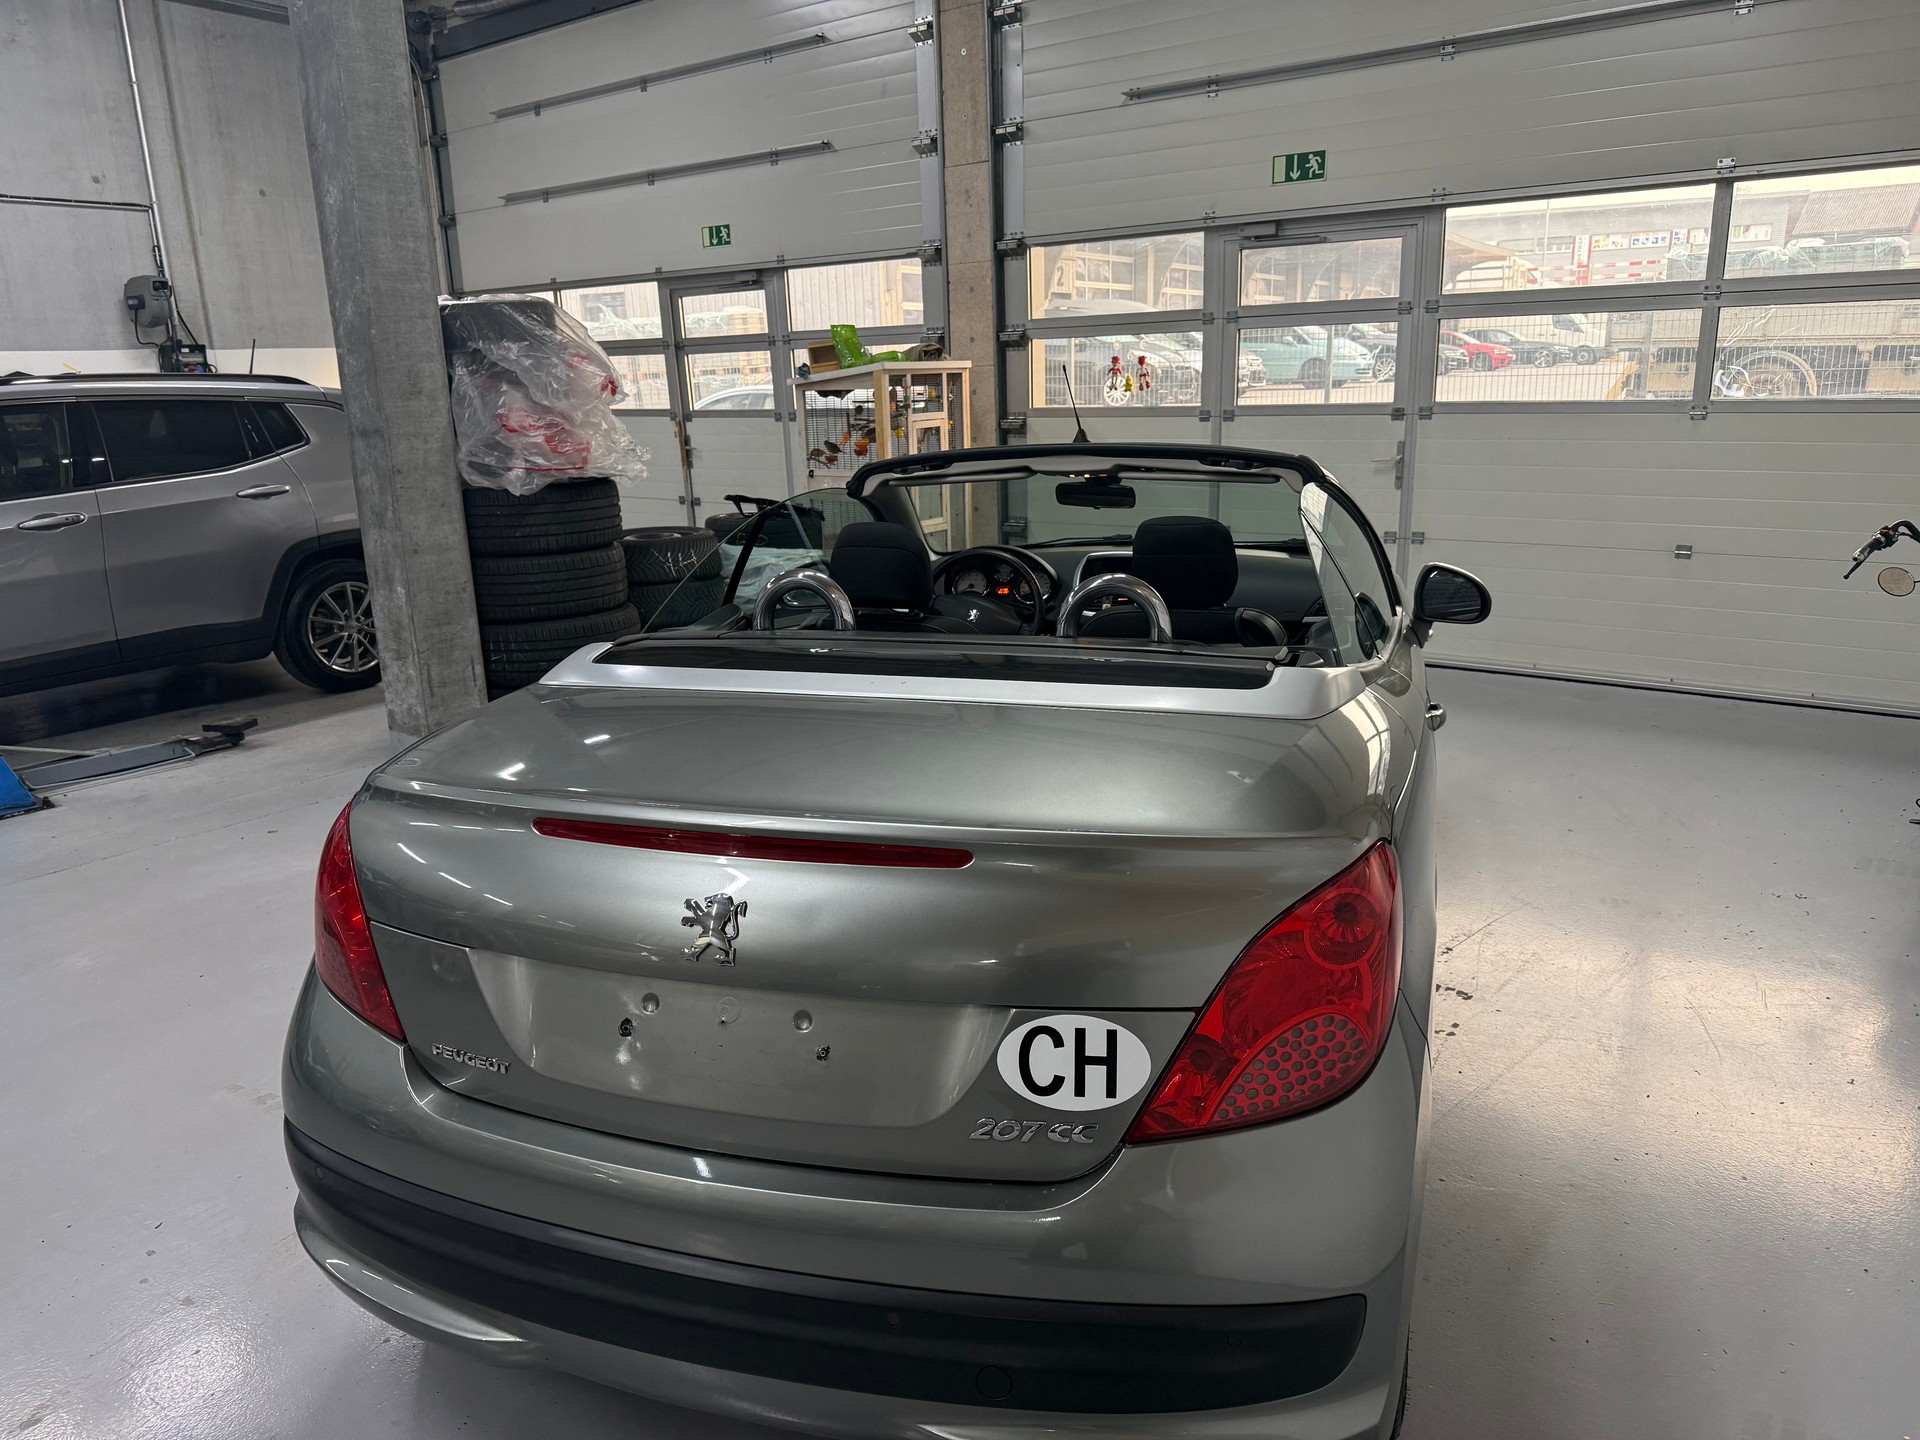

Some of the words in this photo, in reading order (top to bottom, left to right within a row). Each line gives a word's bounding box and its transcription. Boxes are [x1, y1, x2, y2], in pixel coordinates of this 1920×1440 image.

[1056, 265, 1065, 286] 2
[432, 1042, 511, 1074] PEUGEOT
[1018, 1025, 1118, 1099] CH
[969, 1118, 1046, 1143] 207
